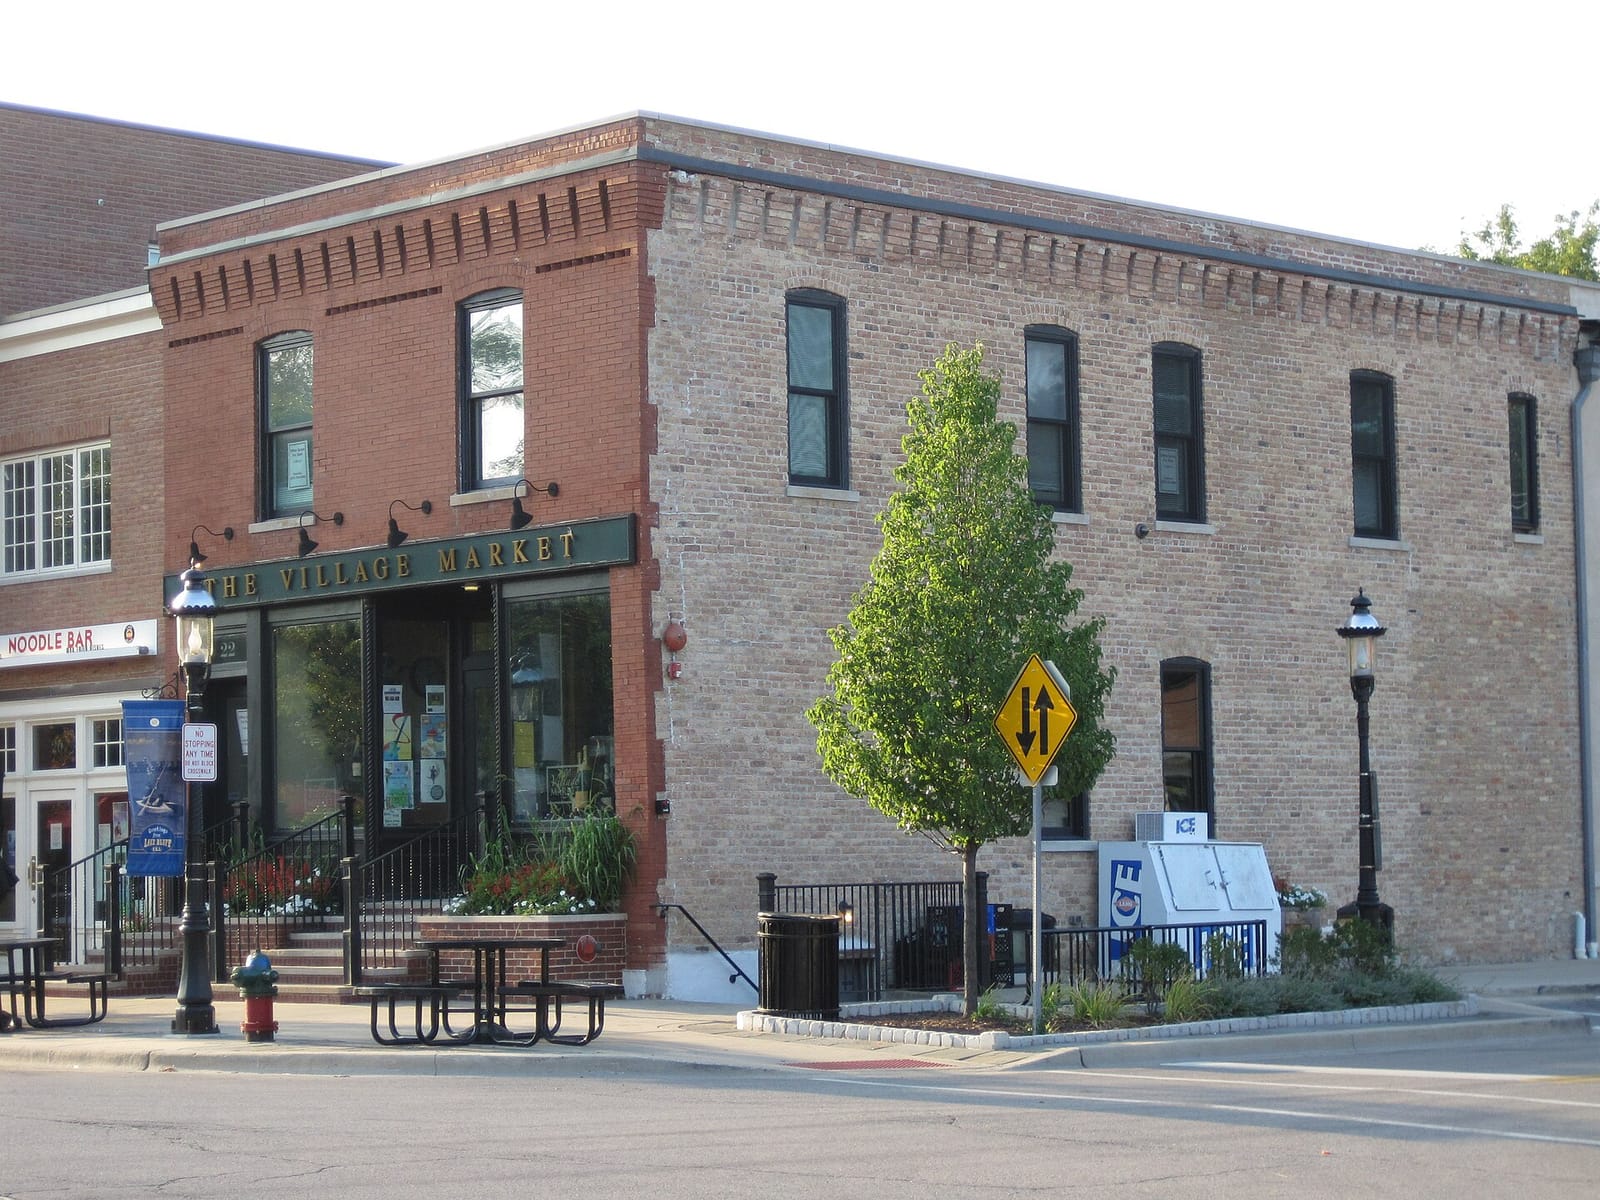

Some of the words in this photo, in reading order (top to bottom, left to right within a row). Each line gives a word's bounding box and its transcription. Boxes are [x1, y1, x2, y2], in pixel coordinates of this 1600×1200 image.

[204, 573, 257, 598] THE
[280, 554, 410, 591] VILLAGE
[438, 533, 574, 573] MARKET
[8, 632, 62, 654] NOODLE
[67, 629, 93, 649] BAR
[220, 641, 236, 657] 22
[195, 730, 204, 738] NO
[185, 740, 214, 748] STOPPING
[185, 750, 197, 758] ANY
[200, 750, 214, 758] TIME
[1176, 817, 1196, 834] ICE
